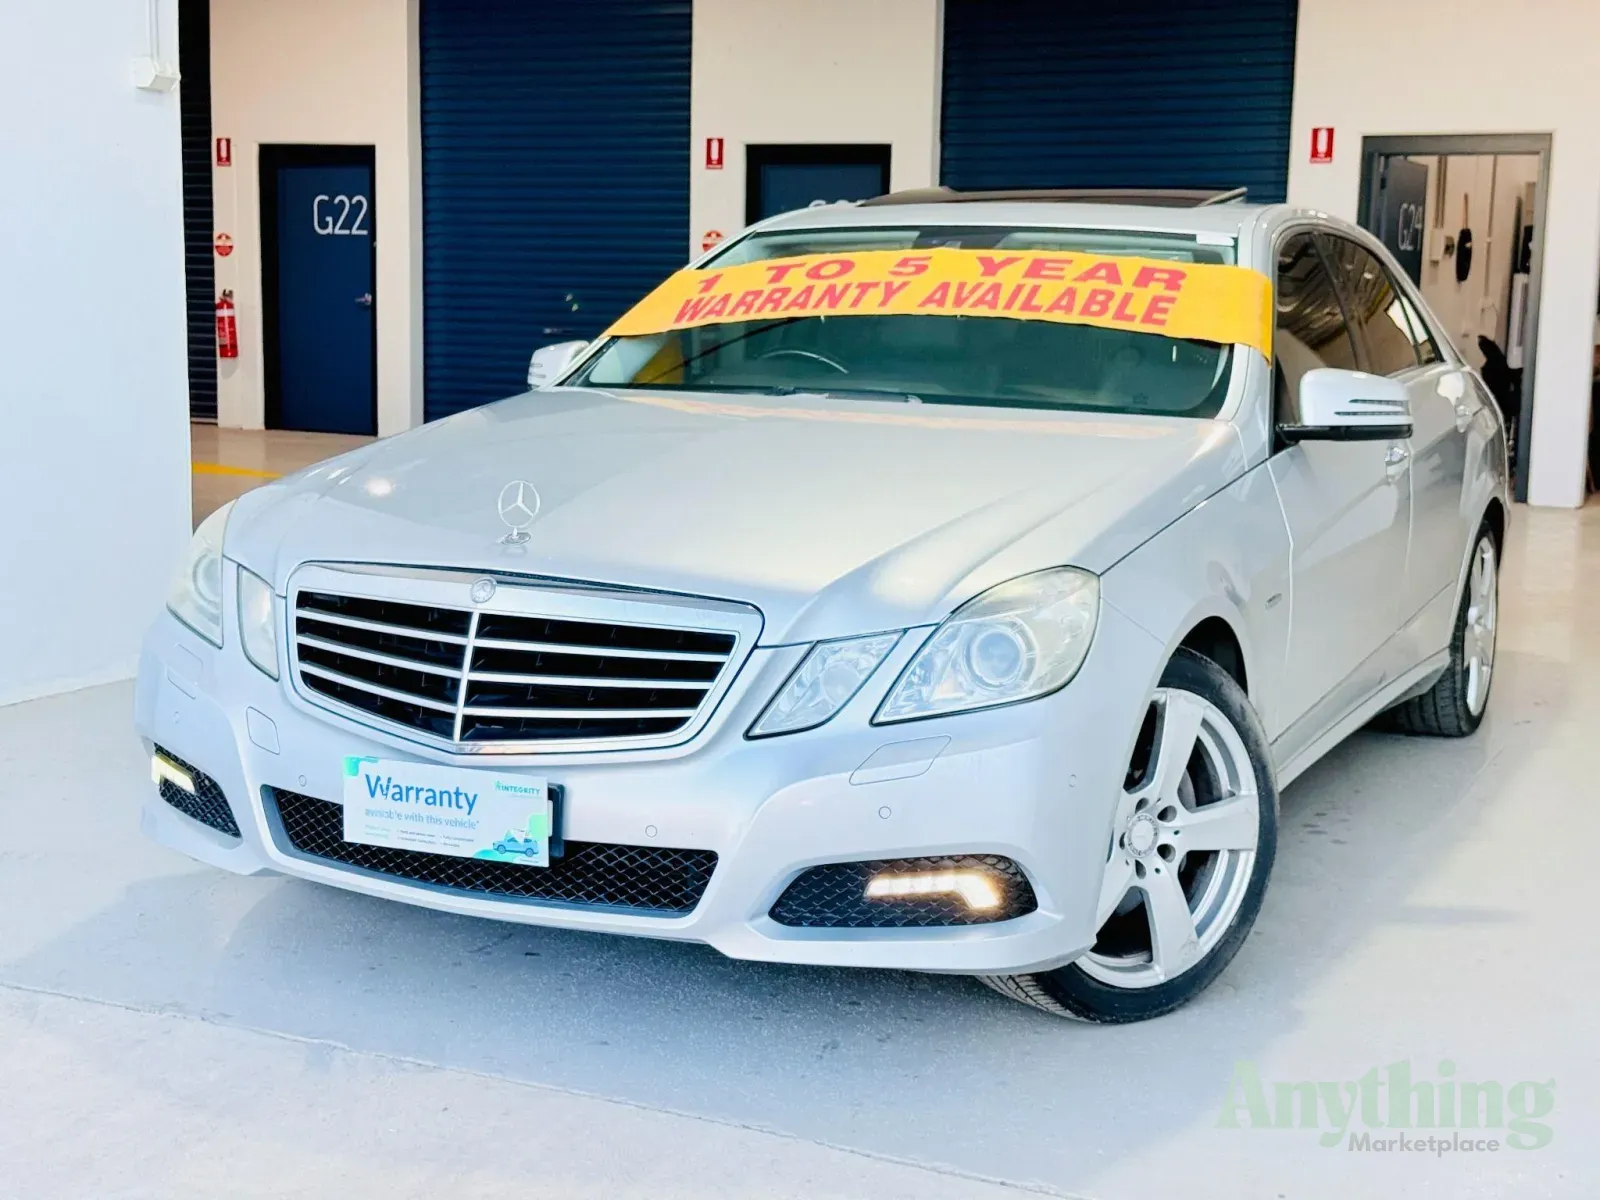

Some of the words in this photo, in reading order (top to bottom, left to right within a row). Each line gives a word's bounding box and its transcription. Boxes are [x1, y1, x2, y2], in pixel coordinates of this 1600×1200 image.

[313, 194, 368, 235] G22
[698, 273, 724, 293] 1
[766, 259, 856, 285] TO
[888, 255, 932, 277] 5
[976, 256, 1187, 292] YEAR
[673, 281, 912, 325] WARRANTY
[918, 281, 1177, 326] AVAILABLE
[365, 773, 478, 816] Warranty
[501, 784, 541, 795] INTEGRITY
[404, 811, 424, 823] with
[426, 812, 443, 825] this
